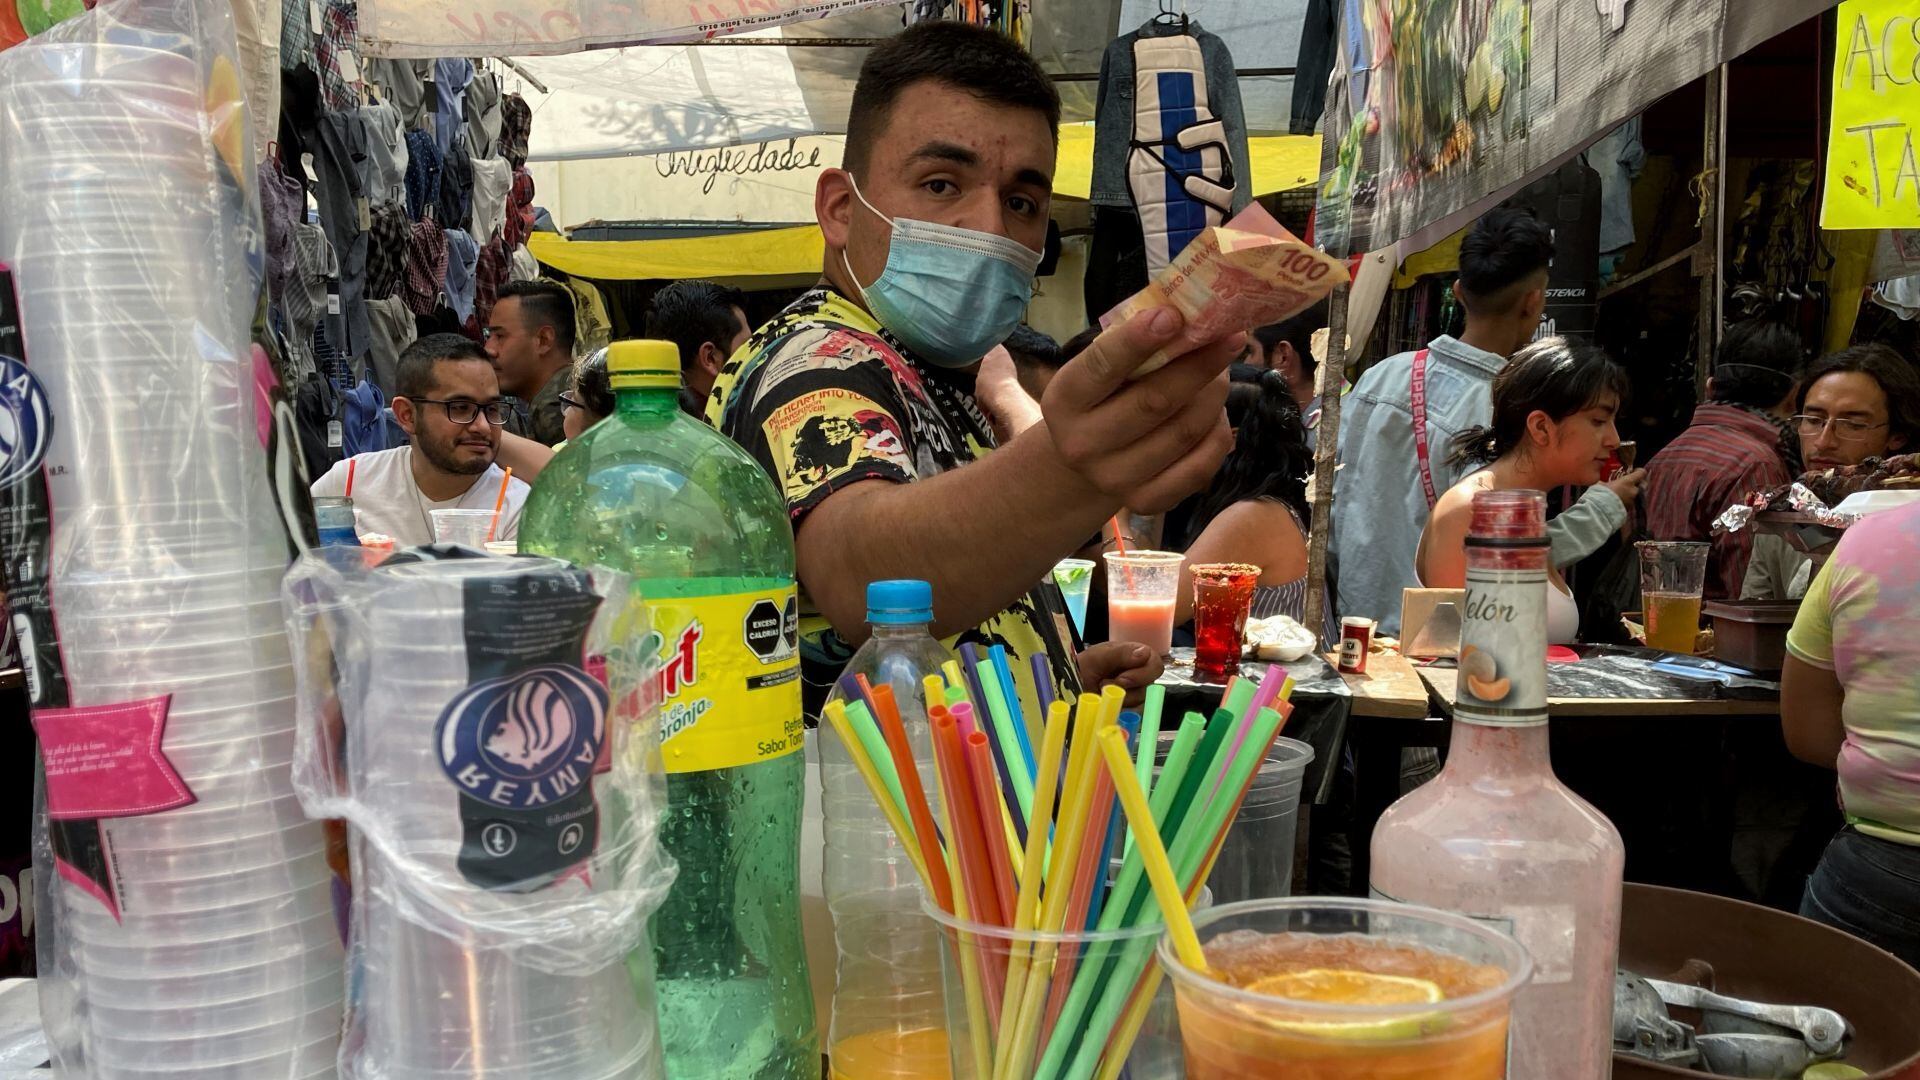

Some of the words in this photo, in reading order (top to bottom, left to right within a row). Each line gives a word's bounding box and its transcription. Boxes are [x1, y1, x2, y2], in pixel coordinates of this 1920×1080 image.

[1183, 264, 1194, 277] de
[1277, 248, 1330, 282] 100
[1544, 288, 1586, 297] STENCIA
[784, 393, 816, 415] HEART
[819, 389, 844, 399] INTO
[1411, 358, 1427, 445] SUPREME
[752, 619, 777, 629] EXCESO
[670, 703, 684, 720] de
[757, 738, 787, 756] Sabor
